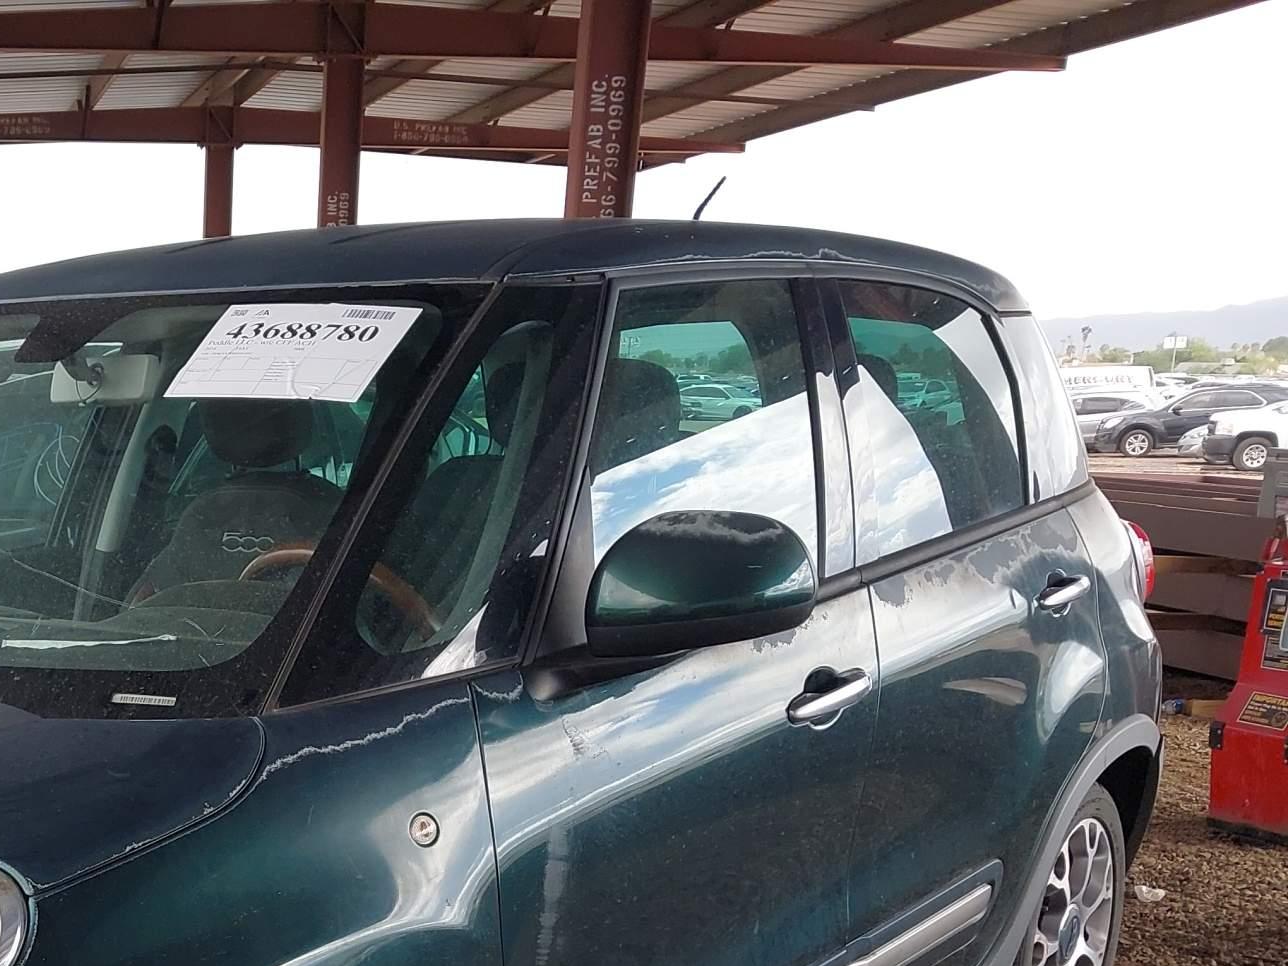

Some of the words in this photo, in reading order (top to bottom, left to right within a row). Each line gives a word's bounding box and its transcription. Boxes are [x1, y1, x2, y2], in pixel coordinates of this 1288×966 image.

[590, 74, 609, 113] INC.
[582, 124, 604, 203] PREFAB
[225, 321, 381, 343] 43688780
